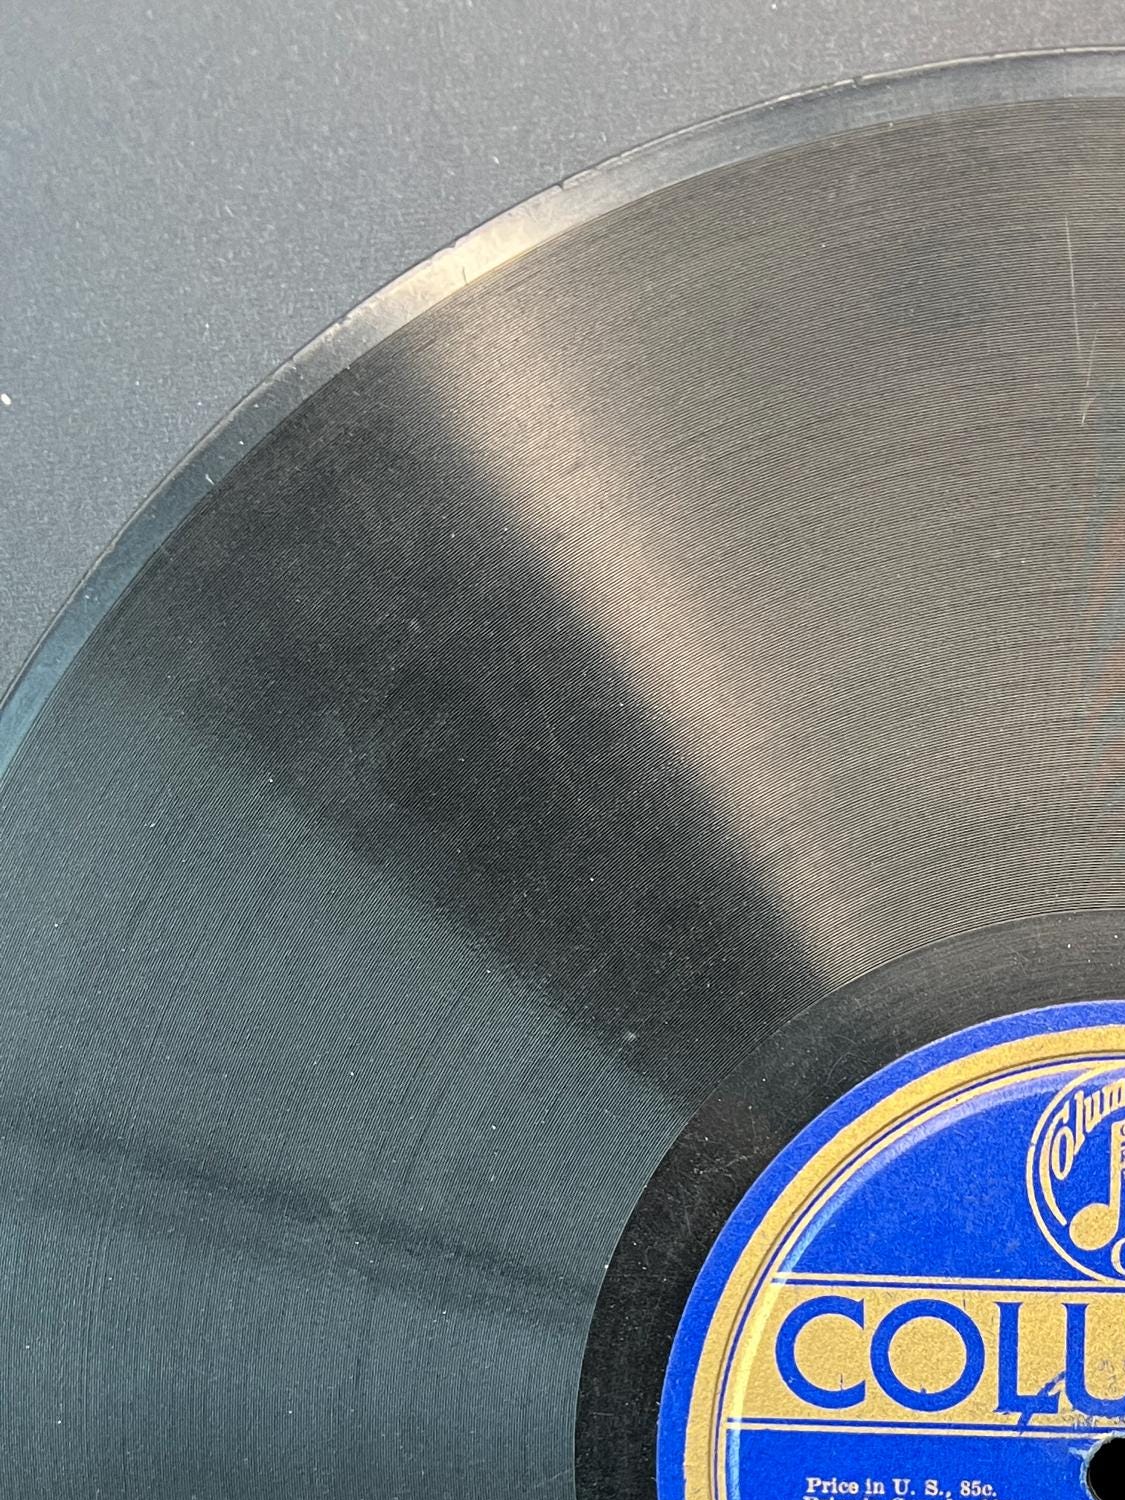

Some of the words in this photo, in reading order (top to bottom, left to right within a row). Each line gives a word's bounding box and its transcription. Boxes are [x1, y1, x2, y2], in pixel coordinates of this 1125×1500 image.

[806, 1477, 859, 1495] Price
[865, 1477, 885, 1495] in
[892, 1478, 916, 1496] U.
[960, 1480, 997, 1497] 85c.
